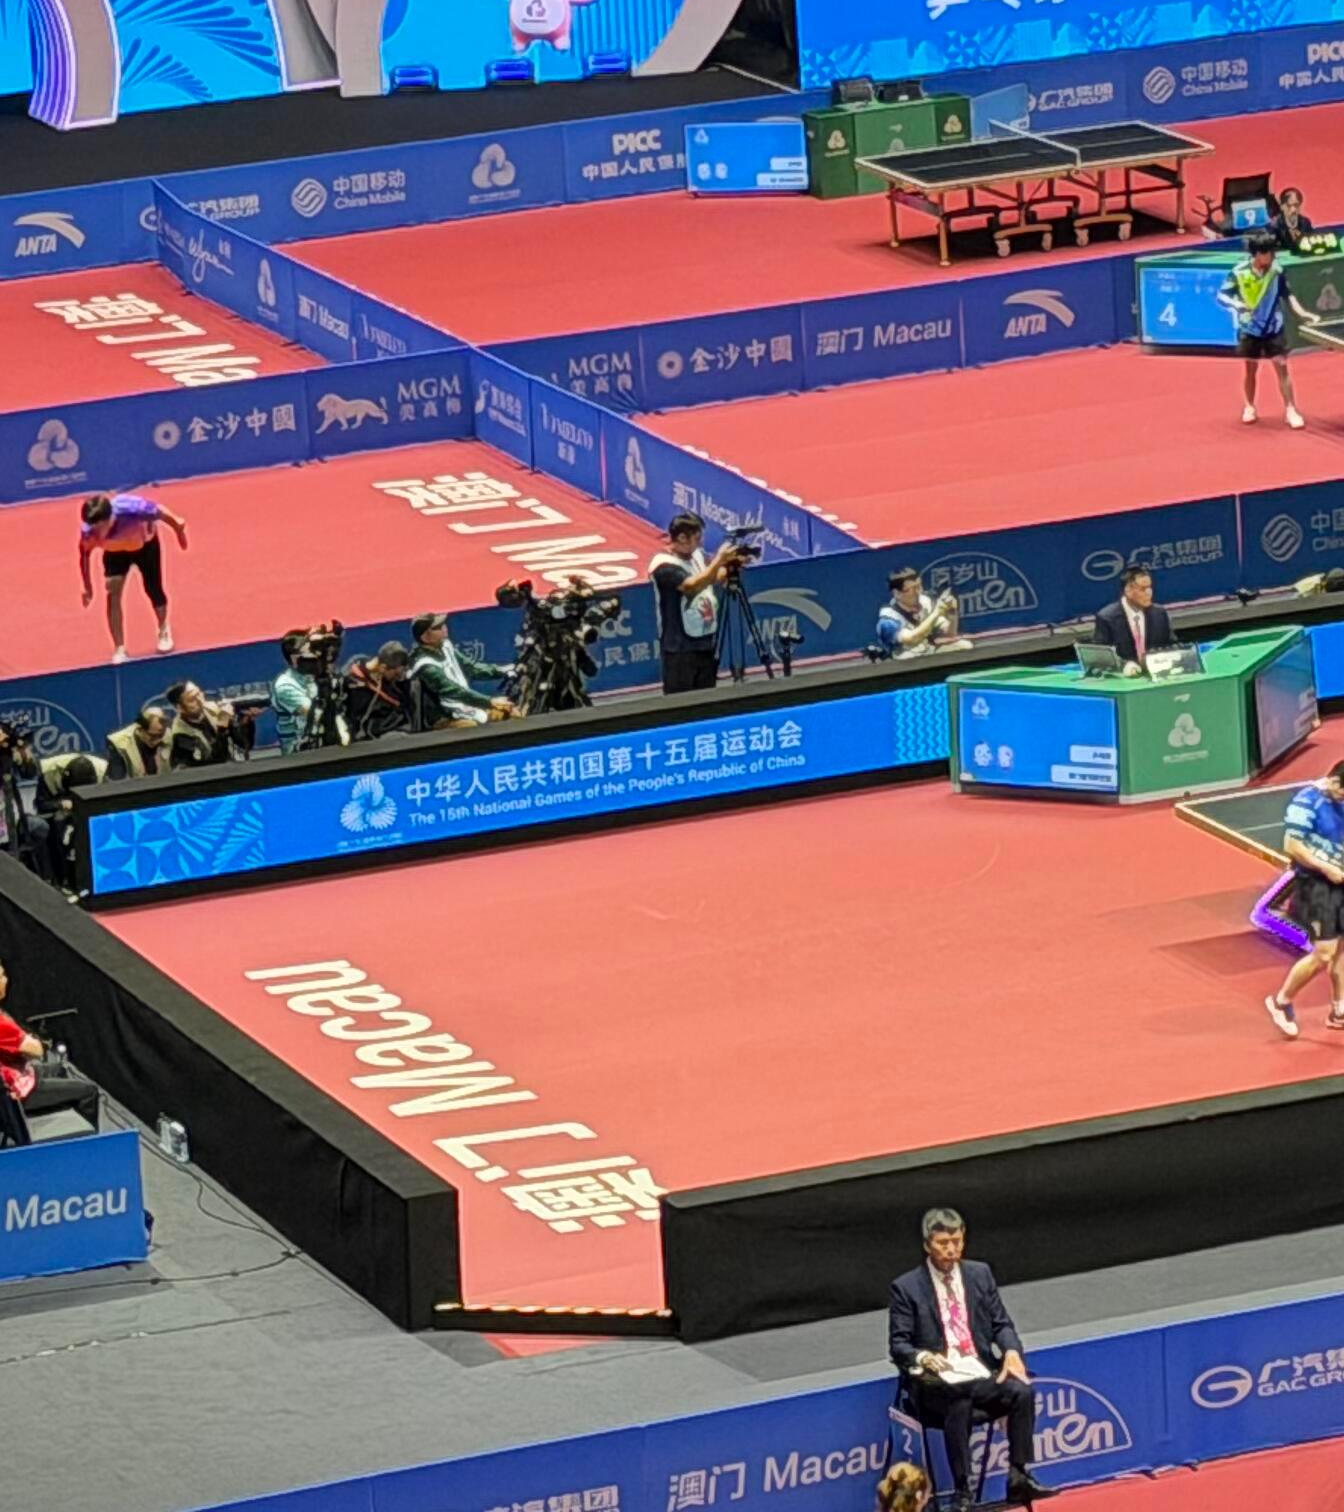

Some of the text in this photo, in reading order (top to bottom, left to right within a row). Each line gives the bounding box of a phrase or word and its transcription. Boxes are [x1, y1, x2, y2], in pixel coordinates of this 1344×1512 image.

[613, 129, 661, 155] PICC
[333, 168, 406, 195] 中国移动
[333, 194, 368, 211] China
[1245, 210, 1255, 225] 9
[15, 234, 58, 258] ANTA
[1004, 312, 1048, 339] ANTA
[1159, 302, 1177, 327] 4
[817, 318, 953, 358] 澳门 Macau
[568, 351, 633, 377] MGM
[397, 375, 463, 403] MGM
[187, 403, 297, 444] 金沙中國
[699, 492, 740, 531] Macau
[405, 719, 803, 806] 中华人民共和国第十五届运动会
[408, 810, 436, 828] The
[473, 795, 532, 818] National
[535, 787, 582, 809] Games
[584, 783, 601, 802] of
[602, 780, 625, 798] the
[628, 771, 686, 795] People's
[688, 760, 748, 786] Republic
[750, 756, 765, 773] of
[766, 752, 806, 771] China
[244, 959, 672, 1234] Macau 澳门
[5, 1186, 128, 1233] Macau
[1257, 1376, 1306, 1398] GAC
[666, 1437, 891, 1512] 澳门 Macau
